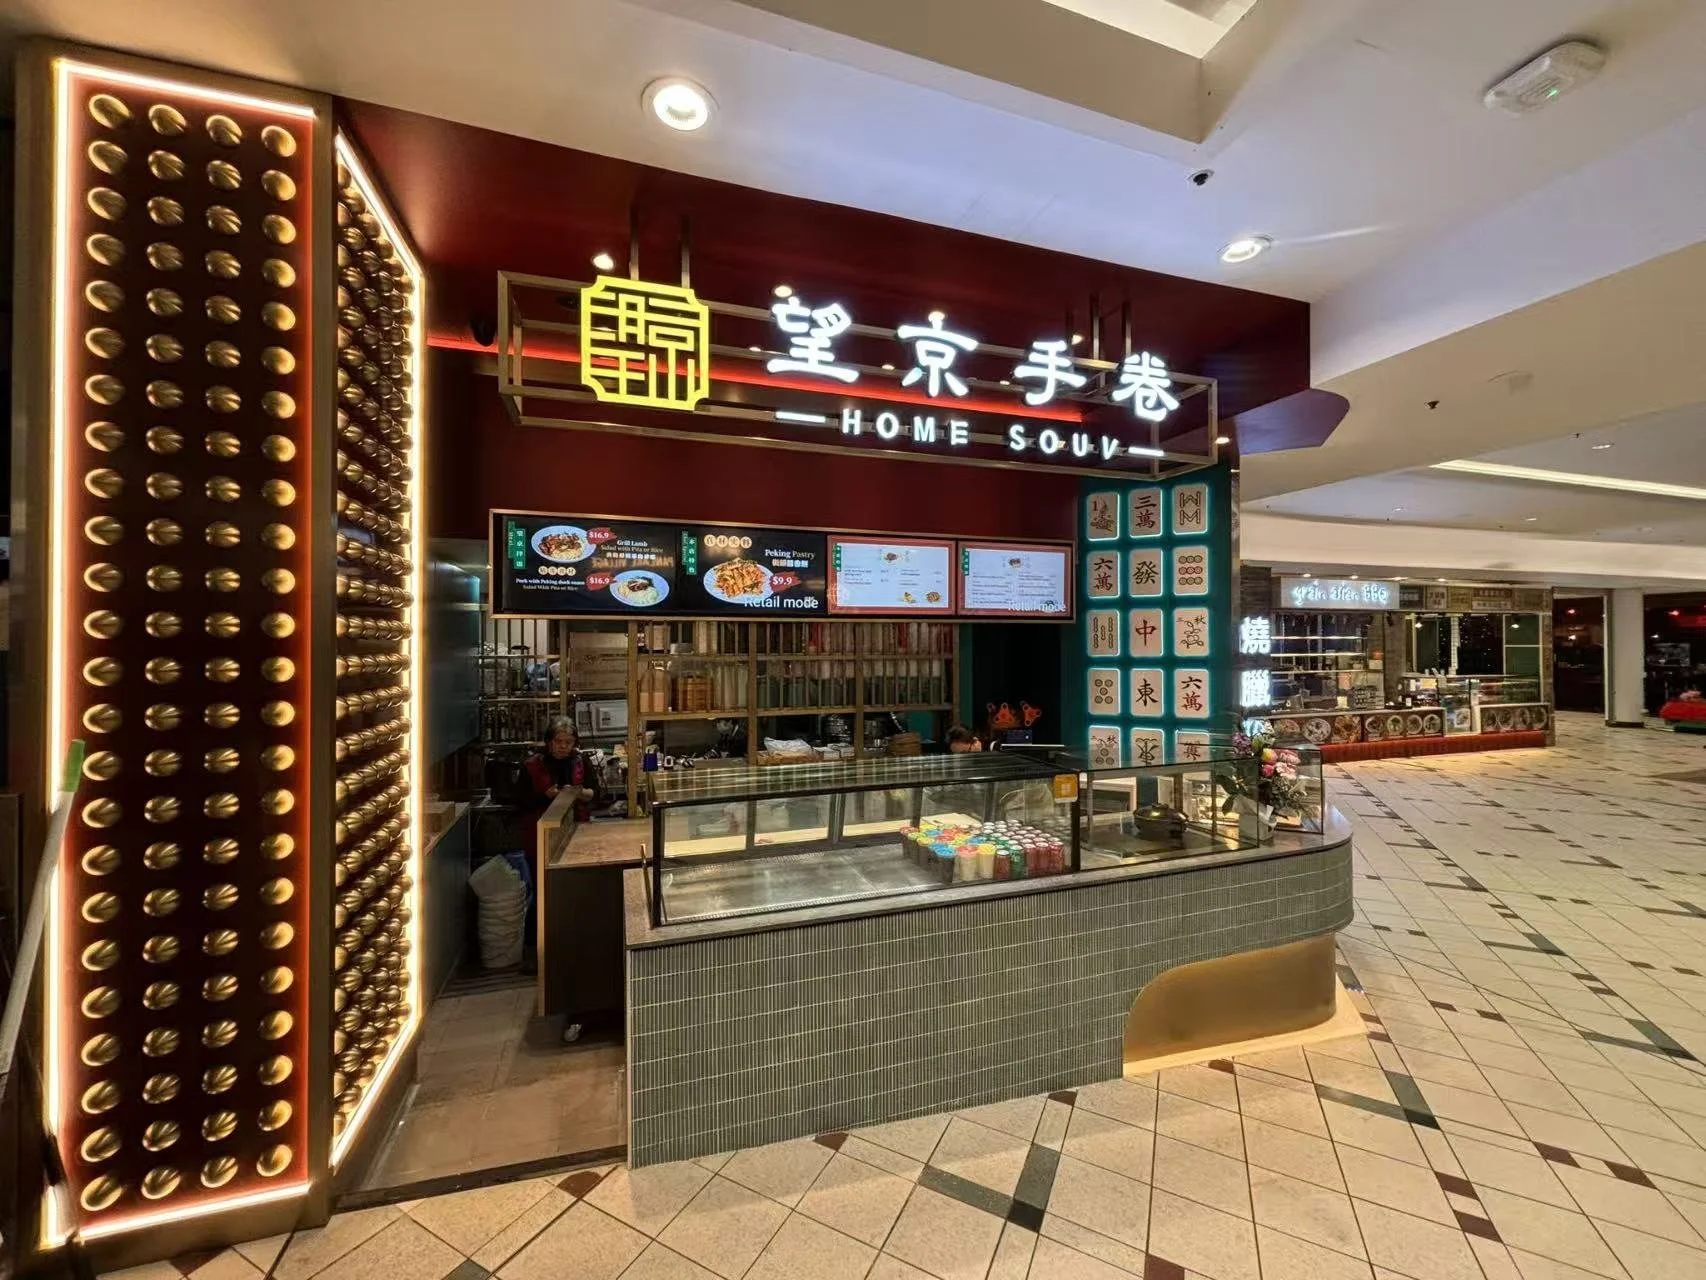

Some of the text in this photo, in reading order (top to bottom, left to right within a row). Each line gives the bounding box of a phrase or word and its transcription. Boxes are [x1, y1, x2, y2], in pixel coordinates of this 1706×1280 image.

[766, 294, 1181, 421] 望京手卷
[841, 408, 1120, 461] HOME SOUV
[588, 531, 610, 539] $16.9
[765, 549, 816, 559] Peking Pastry
[589, 577, 610, 585] $16.9
[772, 576, 792, 585] $9.9
[1094, 558, 1113, 591] 六萬
[1132, 560, 1159, 585] 發
[744, 596, 819, 608] Retail mode
[1135, 619, 1157, 647] 中
[1136, 679, 1158, 706] 東
[1181, 676, 1203, 712] 六萬
